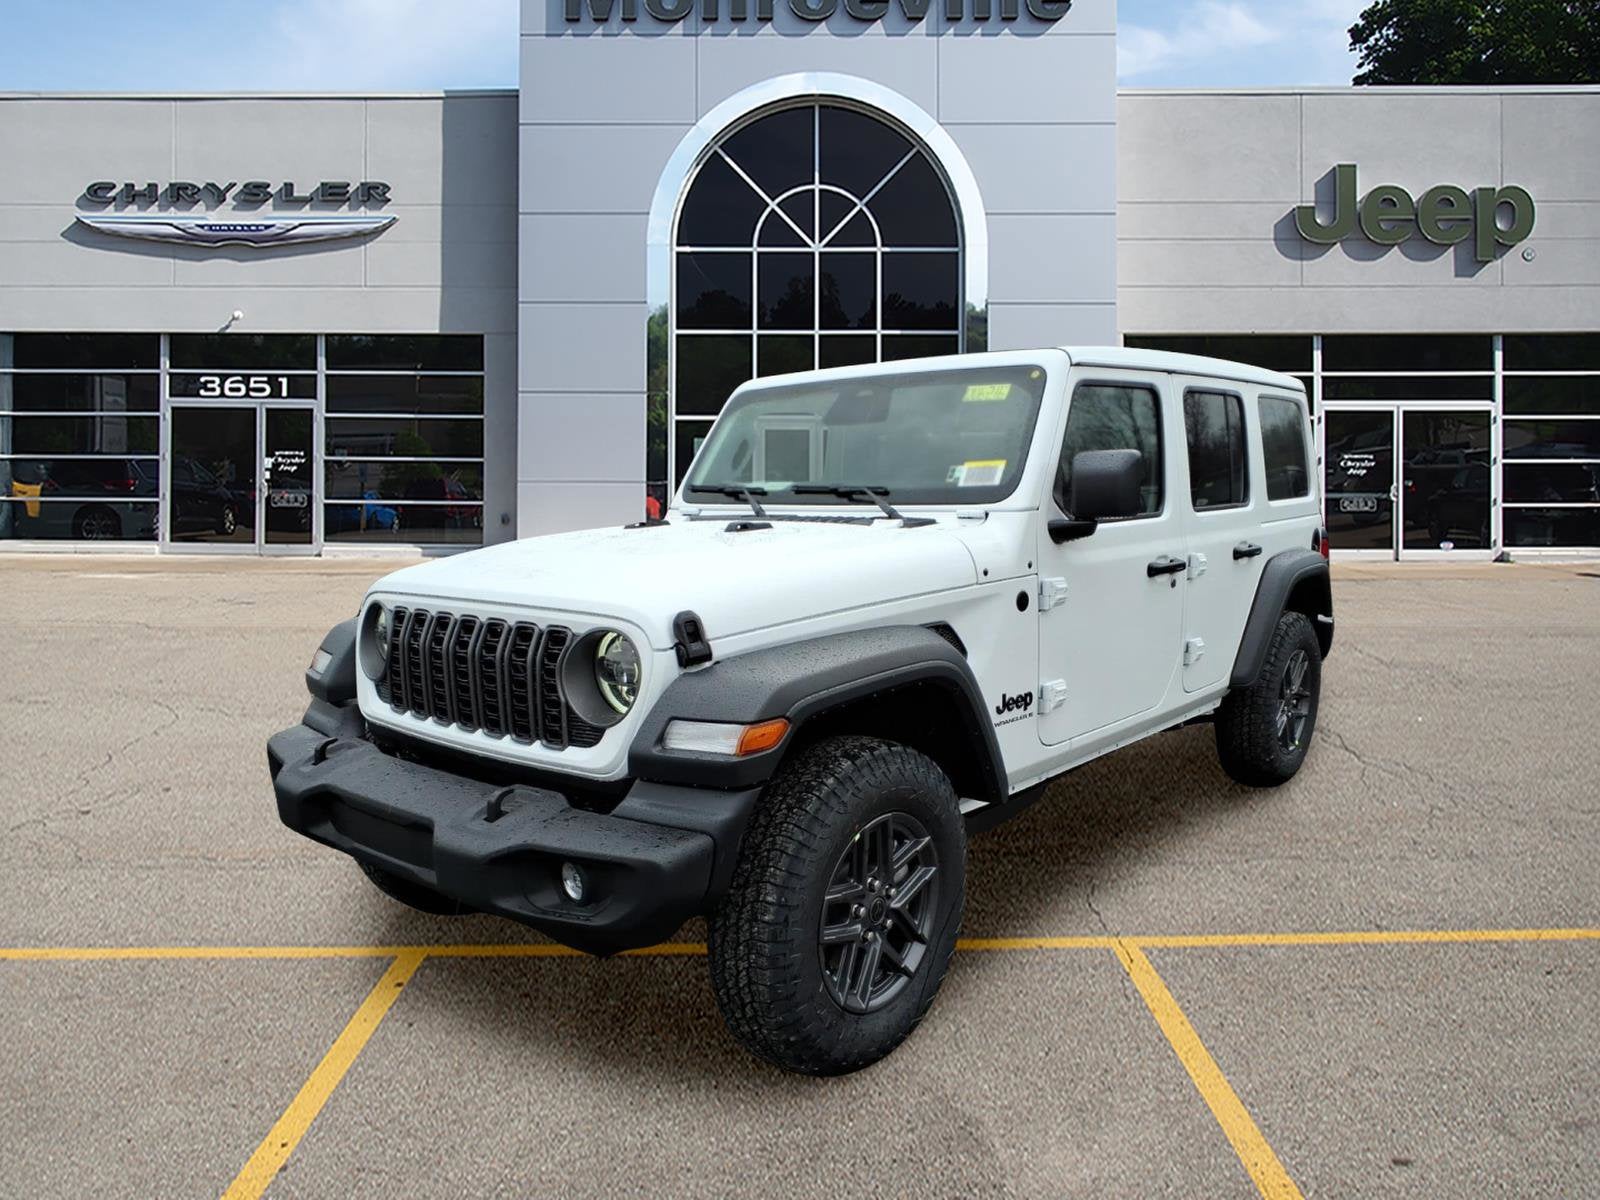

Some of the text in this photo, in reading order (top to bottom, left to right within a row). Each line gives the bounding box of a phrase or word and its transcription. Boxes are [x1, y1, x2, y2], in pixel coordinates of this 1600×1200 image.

[85, 181, 392, 202] CHRYSLER
[1296, 164, 1535, 261] Jeep
[199, 376, 288, 397] 3651
[995, 691, 1033, 715] Jeep
